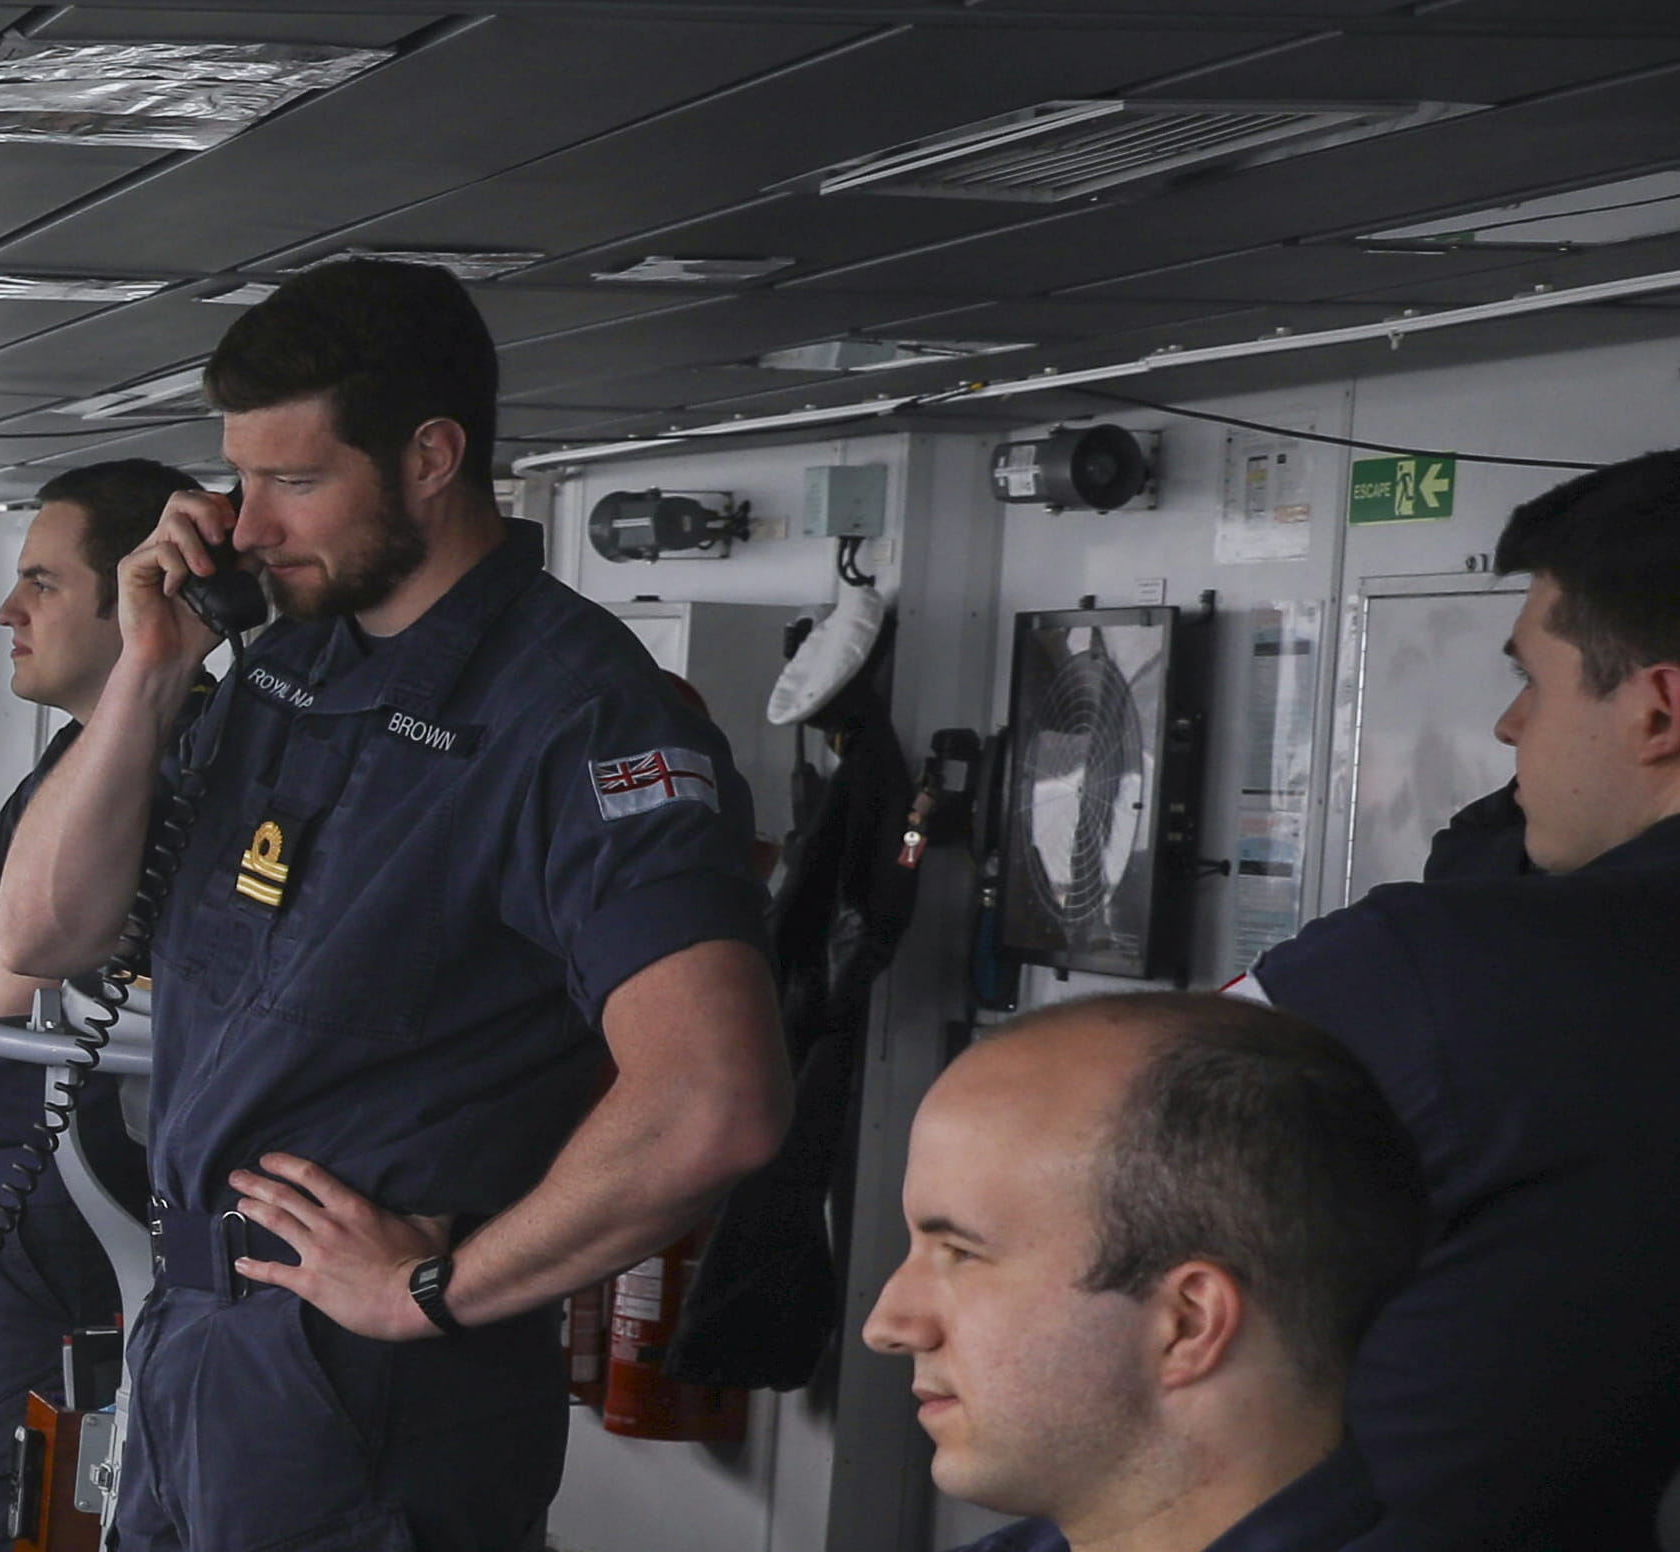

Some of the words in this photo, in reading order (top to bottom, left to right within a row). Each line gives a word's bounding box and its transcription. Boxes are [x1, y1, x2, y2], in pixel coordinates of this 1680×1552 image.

[1354, 481, 1392, 500] ESCAPE
[290, 688, 315, 709] NA
[388, 712, 457, 751] BROWN
